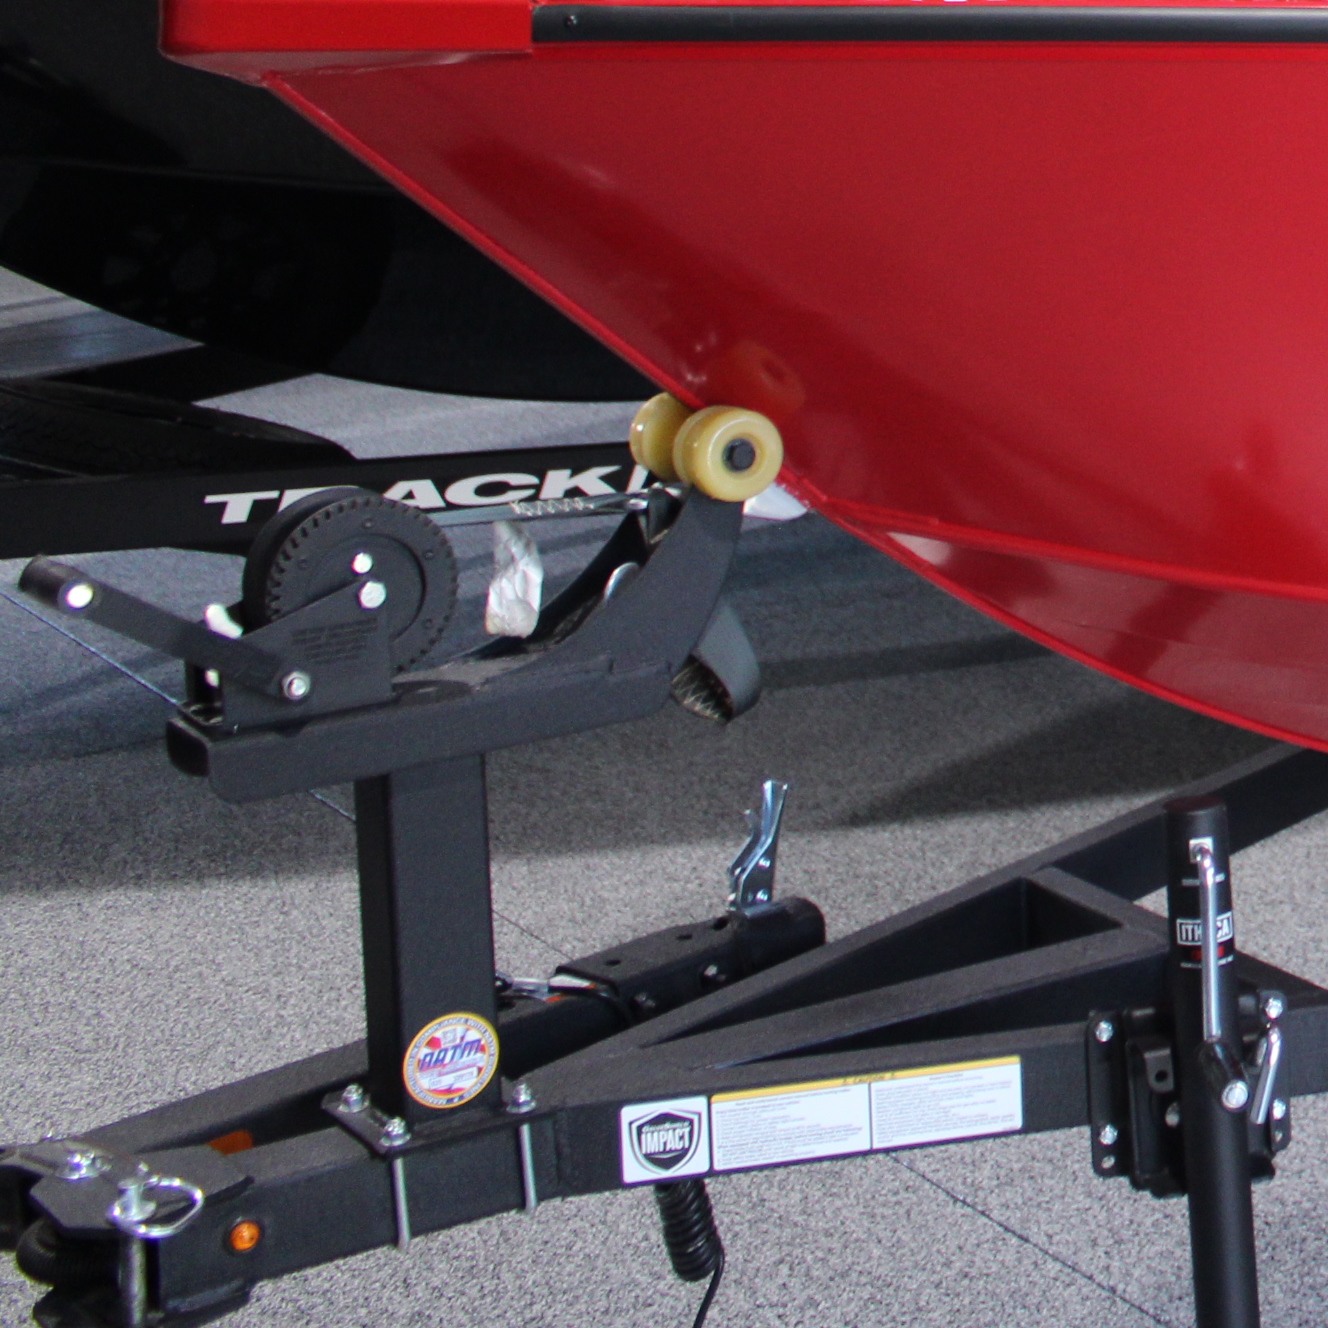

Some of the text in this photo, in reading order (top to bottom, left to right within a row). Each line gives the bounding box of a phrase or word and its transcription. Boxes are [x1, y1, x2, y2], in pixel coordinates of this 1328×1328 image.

[204, 464, 648, 525] TACK
[1181, 918, 1230, 942] ITHCA
[641, 1126, 692, 1155] IMPACT
